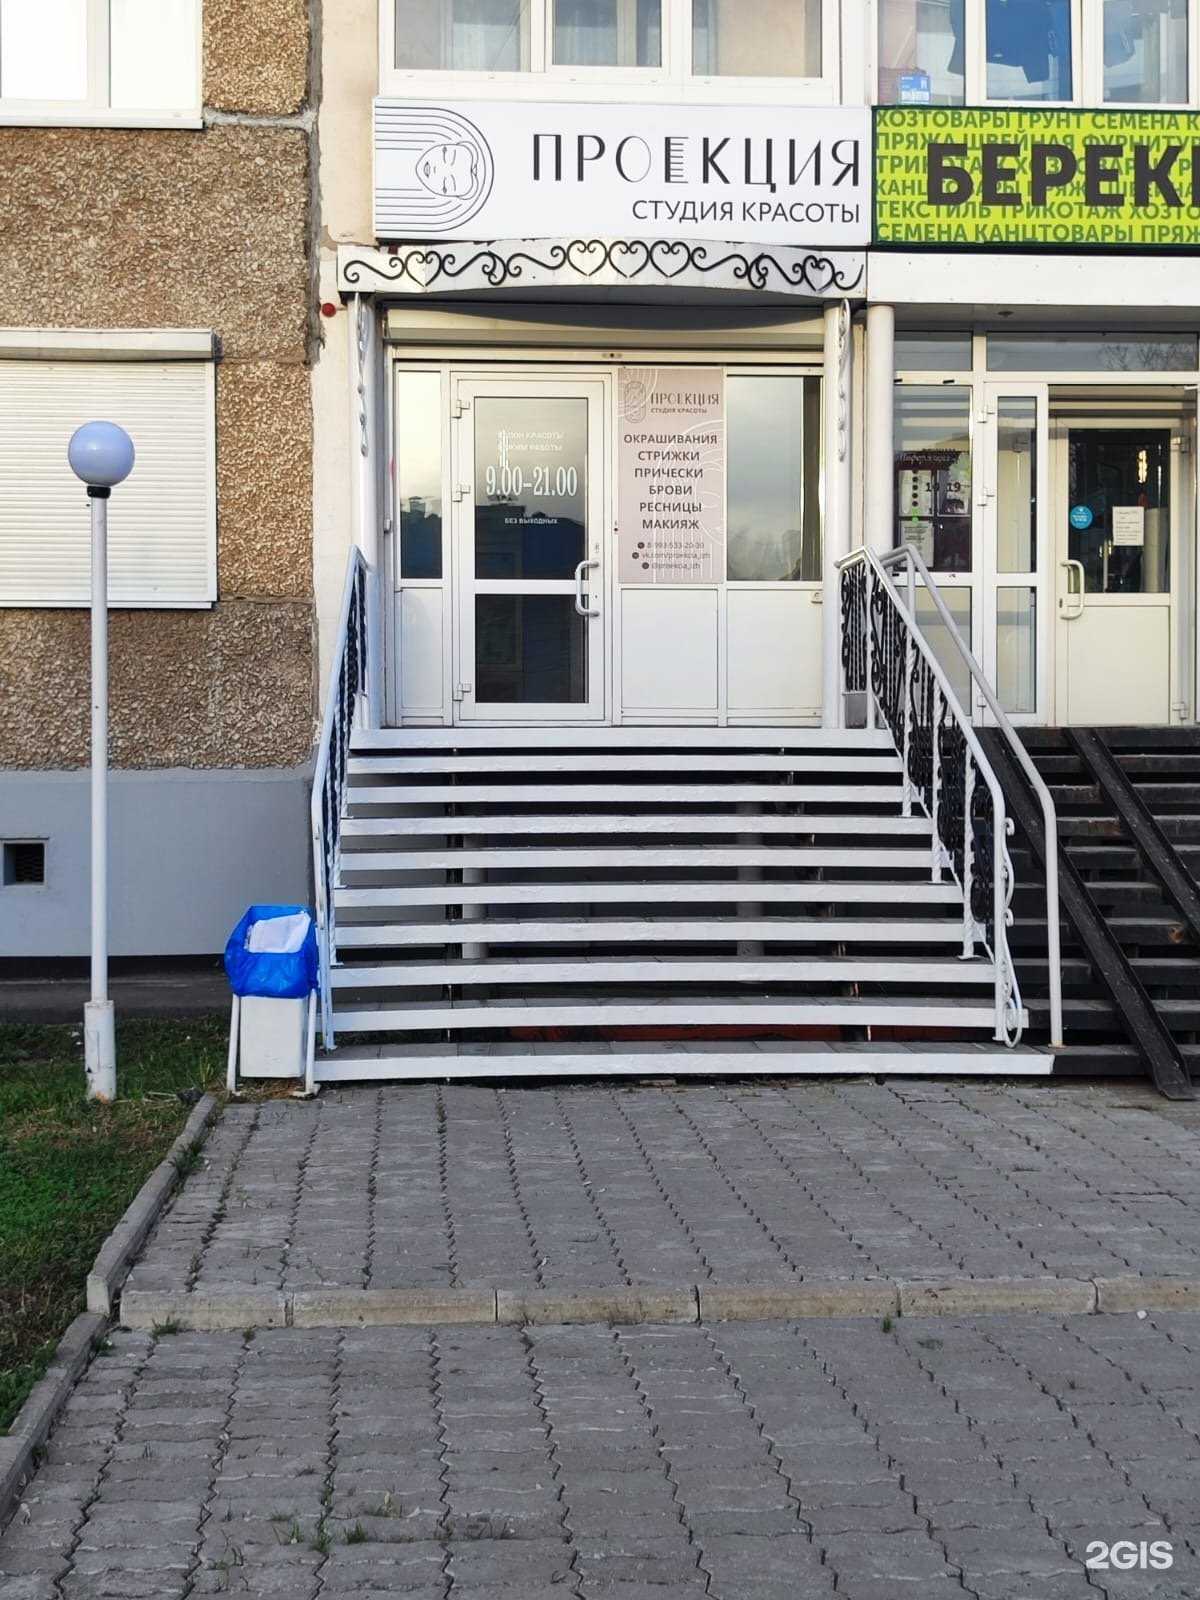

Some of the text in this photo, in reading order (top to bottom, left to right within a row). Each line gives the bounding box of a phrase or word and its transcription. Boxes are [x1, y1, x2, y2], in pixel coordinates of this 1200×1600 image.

[877, 110, 1010, 129] ХОЗТОВАРЫ
[1017, 111, 1085, 129] ГРУНТ
[1091, 113, 1179, 130] СЕМЕНА
[533, 134, 860, 193] ПРОЕКЦИЯ
[632, 200, 860, 224] СТУДИЯ КРАСОТЫ
[877, 200, 992, 219] ТЕКСТИЛЬ
[1000, 202, 1123, 219] ТРИКОТАЖ
[877, 223, 968, 242] СЕМЕНА
[975, 223, 1134, 243] КАНЦТОВАРЫ
[651, 392, 719, 406] ПРОЕКЦИЯ
[623, 434, 718, 444] ОКРАШИВАНИЯ
[638, 451, 700, 461] СТРИЖКИ
[634, 468, 703, 478] ПРИЧЕСКИ
[649, 485, 693, 495] БРОВИ
[639, 502, 702, 514] РЕСНИЦЫ
[642, 519, 700, 530] МАКИЯЖ
